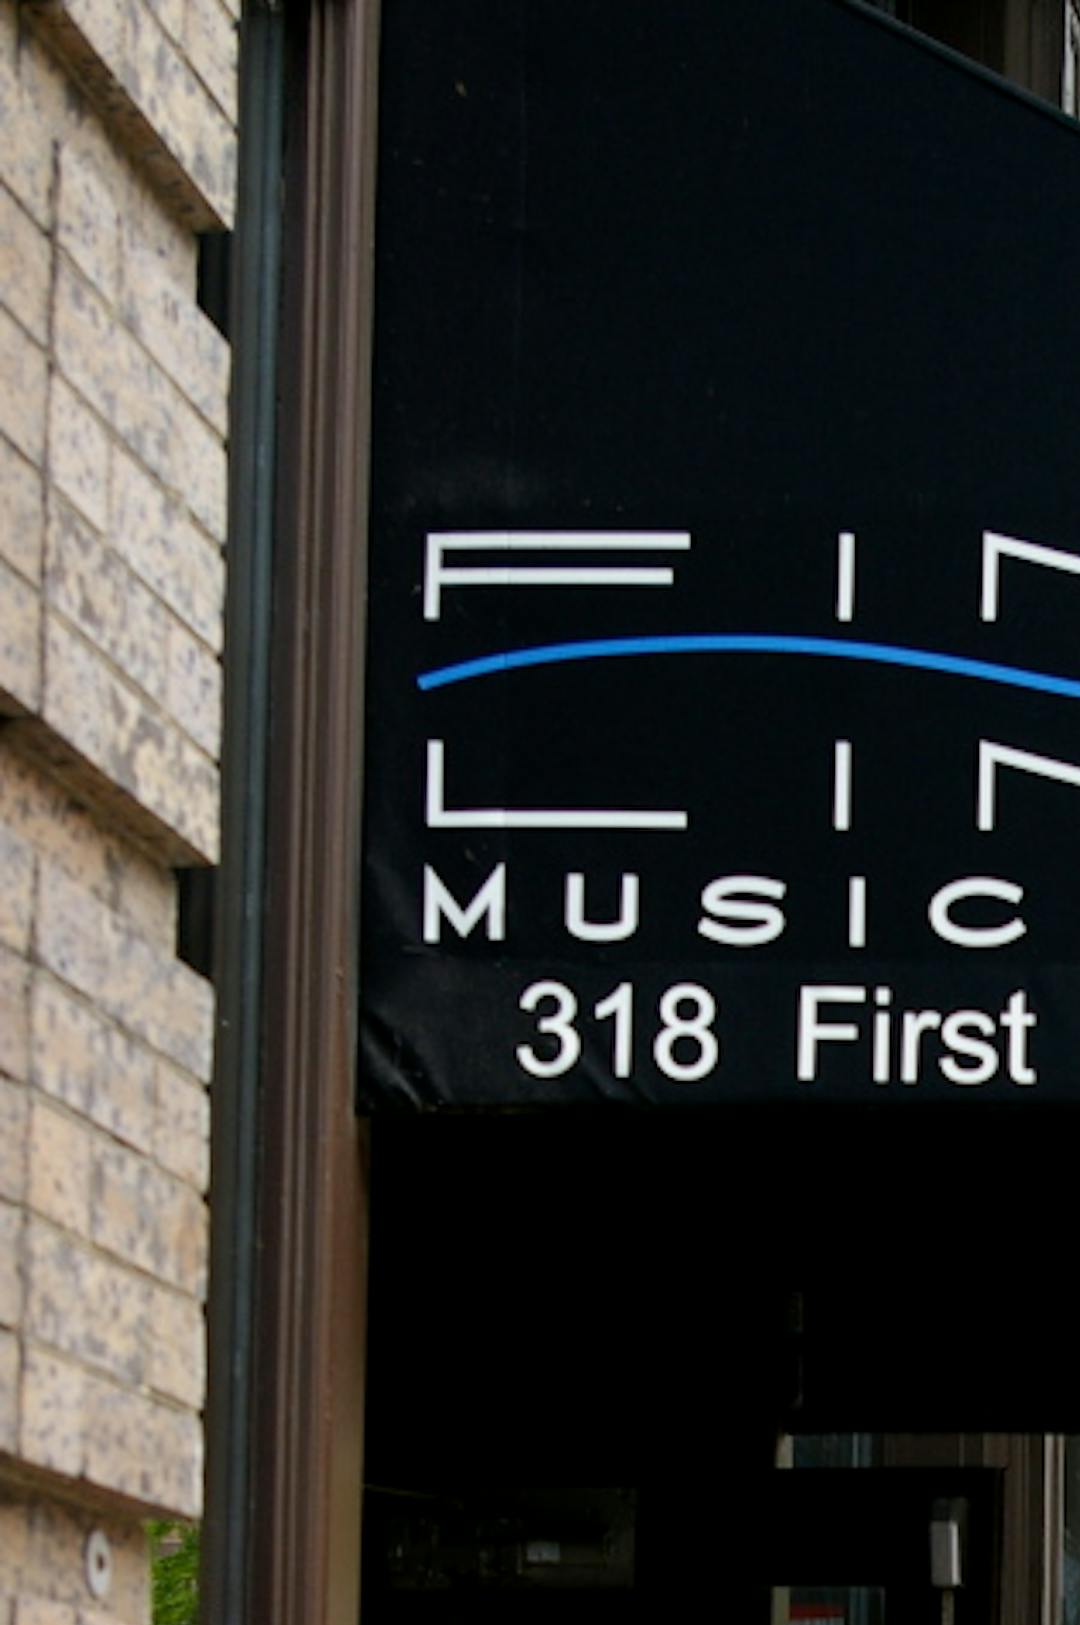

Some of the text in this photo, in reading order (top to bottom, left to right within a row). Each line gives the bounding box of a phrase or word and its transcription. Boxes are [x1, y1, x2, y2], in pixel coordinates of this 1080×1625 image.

[423, 863, 1027, 948] MUSIC
[516, 981, 718, 1081] 318
[797, 985, 1036, 1085] First
